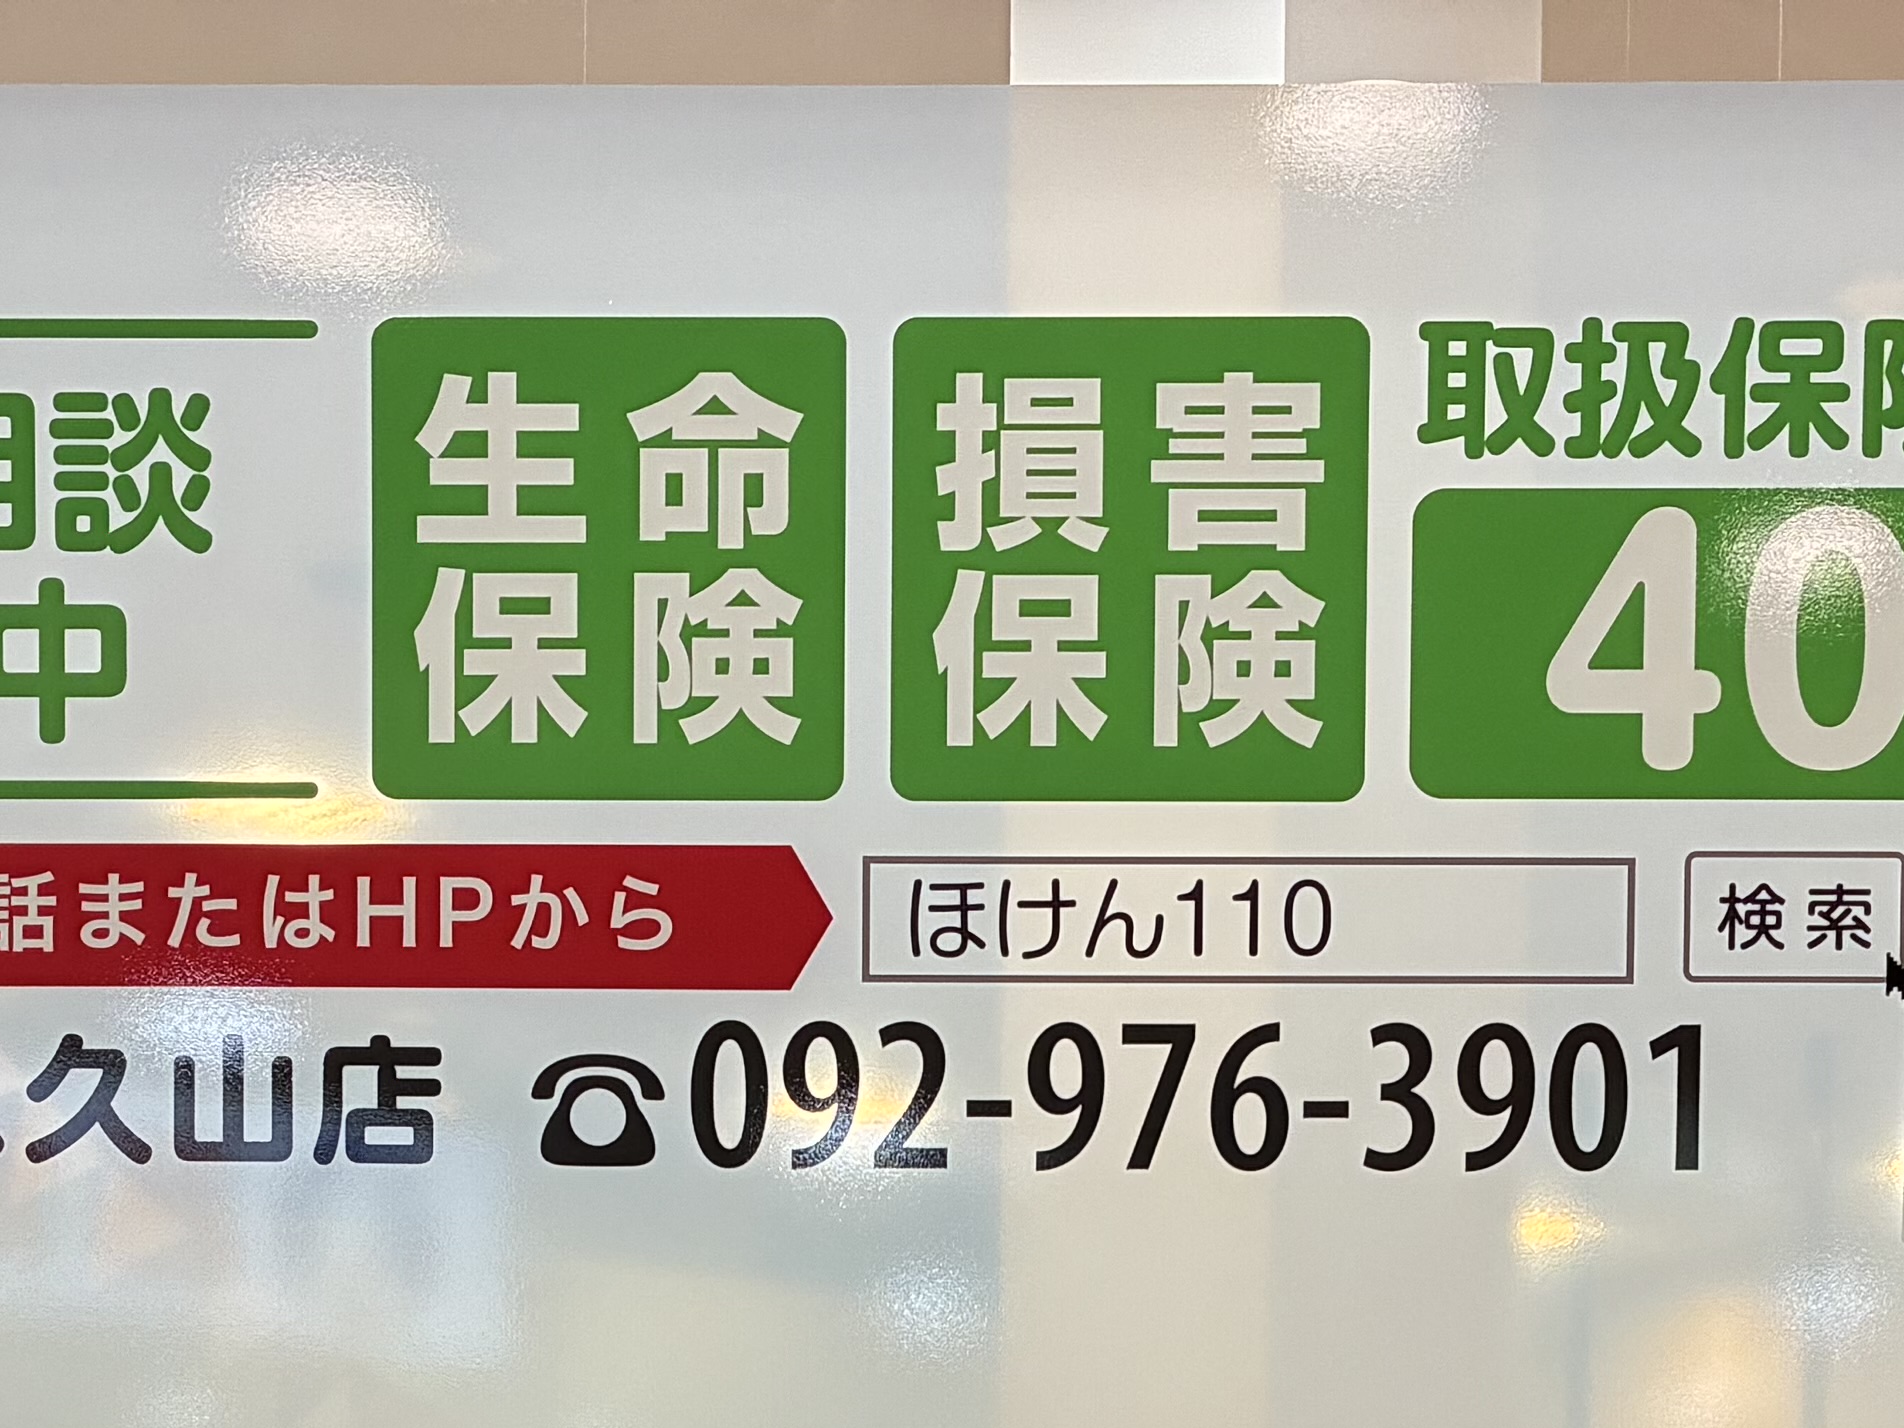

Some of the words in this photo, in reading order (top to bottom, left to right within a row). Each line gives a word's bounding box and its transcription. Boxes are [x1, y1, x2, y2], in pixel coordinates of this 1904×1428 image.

[412, 371, 807, 550] 生命
[936, 371, 1327, 553] 損害
[415, 567, 804, 746] 保険
[931, 567, 1326, 749] 保険
[910, 876, 1333, 961] ほけん110
[1717, 880, 1876, 954] 検索
[691, 1021, 1702, 1174] 092-976-3901
